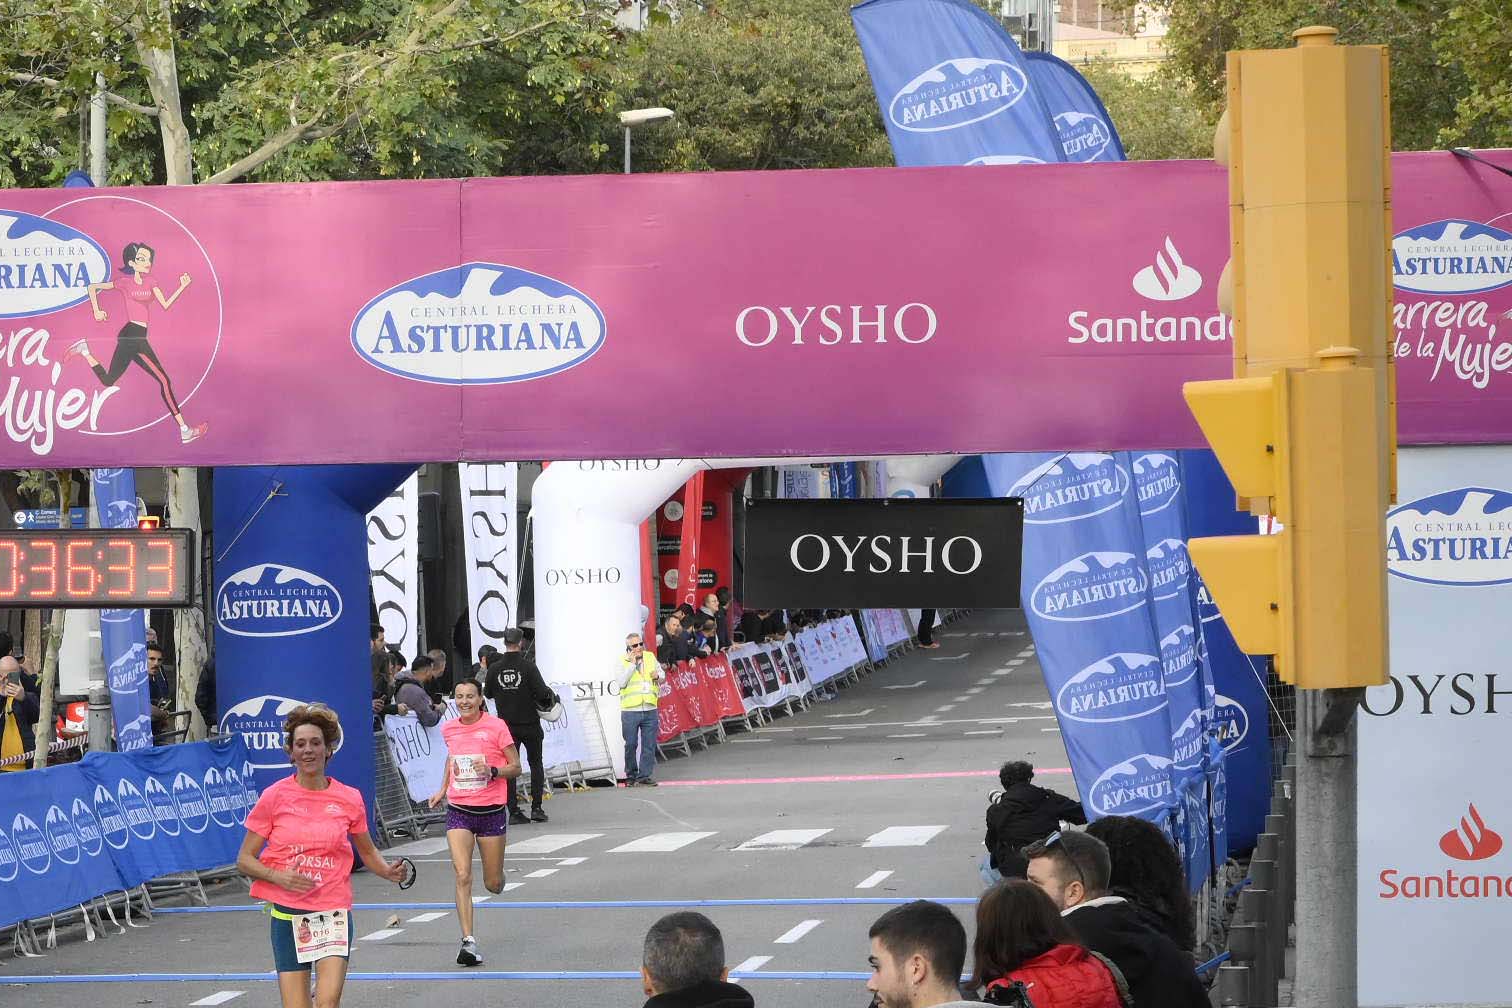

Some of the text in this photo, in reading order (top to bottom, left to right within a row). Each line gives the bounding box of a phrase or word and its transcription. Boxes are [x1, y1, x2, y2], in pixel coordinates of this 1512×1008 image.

[14, 246, 86, 258] LECHERA
[410, 303, 577, 318] CENTRAL LECHERA
[735, 302, 937, 347] OYSHO
[1393, 301, 1488, 329] arrera
[371, 311, 585, 355] ASTURIANA
[1068, 310, 1233, 343] Santand
[1417, 330, 1434, 357] la
[1430, 328, 1512, 389] Muje
[1414, 522, 1481, 532] CENTRAL
[790, 533, 983, 575] OYSHO
[545, 567, 621, 586] OYSHO
[233, 588, 328, 597] CENTRAL LECHERA
[221, 594, 333, 620] ASTURIANA
[503, 675, 515, 683] BP
[1359, 673, 1512, 716] OYSH
[1379, 869, 1512, 898] Santan
